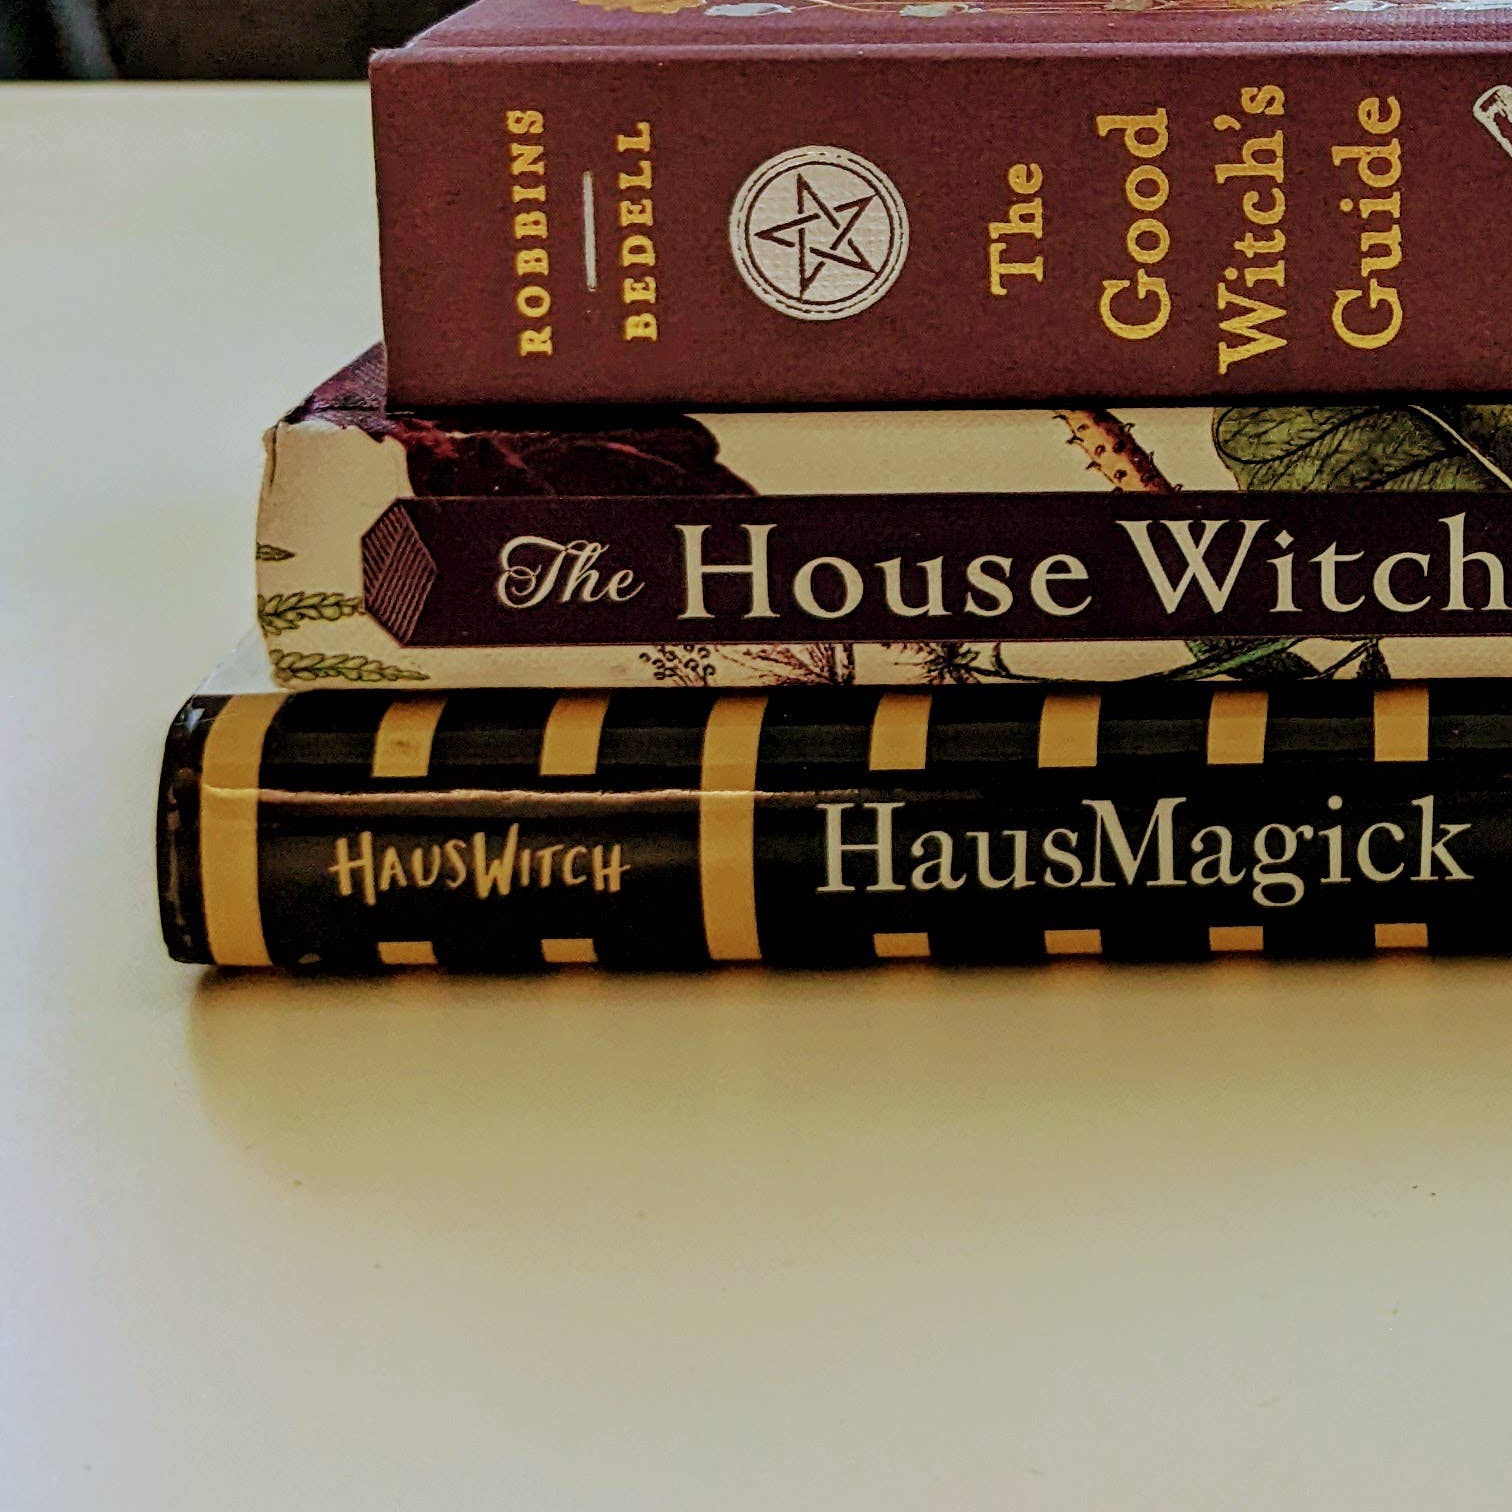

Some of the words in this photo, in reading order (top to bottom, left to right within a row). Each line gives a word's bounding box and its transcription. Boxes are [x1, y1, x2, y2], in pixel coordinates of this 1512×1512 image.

[506, 109, 553, 357] ROBBINS
[617, 121, 658, 341] BEDELL
[988, 162, 1044, 296] The
[1095, 107, 1172, 340] Good
[1213, 84, 1288, 375] Witch's
[1331, 95, 1403, 350] Guide
[496, 535, 646, 609] The
[674, 523, 1092, 620] House
[815, 794, 1475, 907] HausMagick
